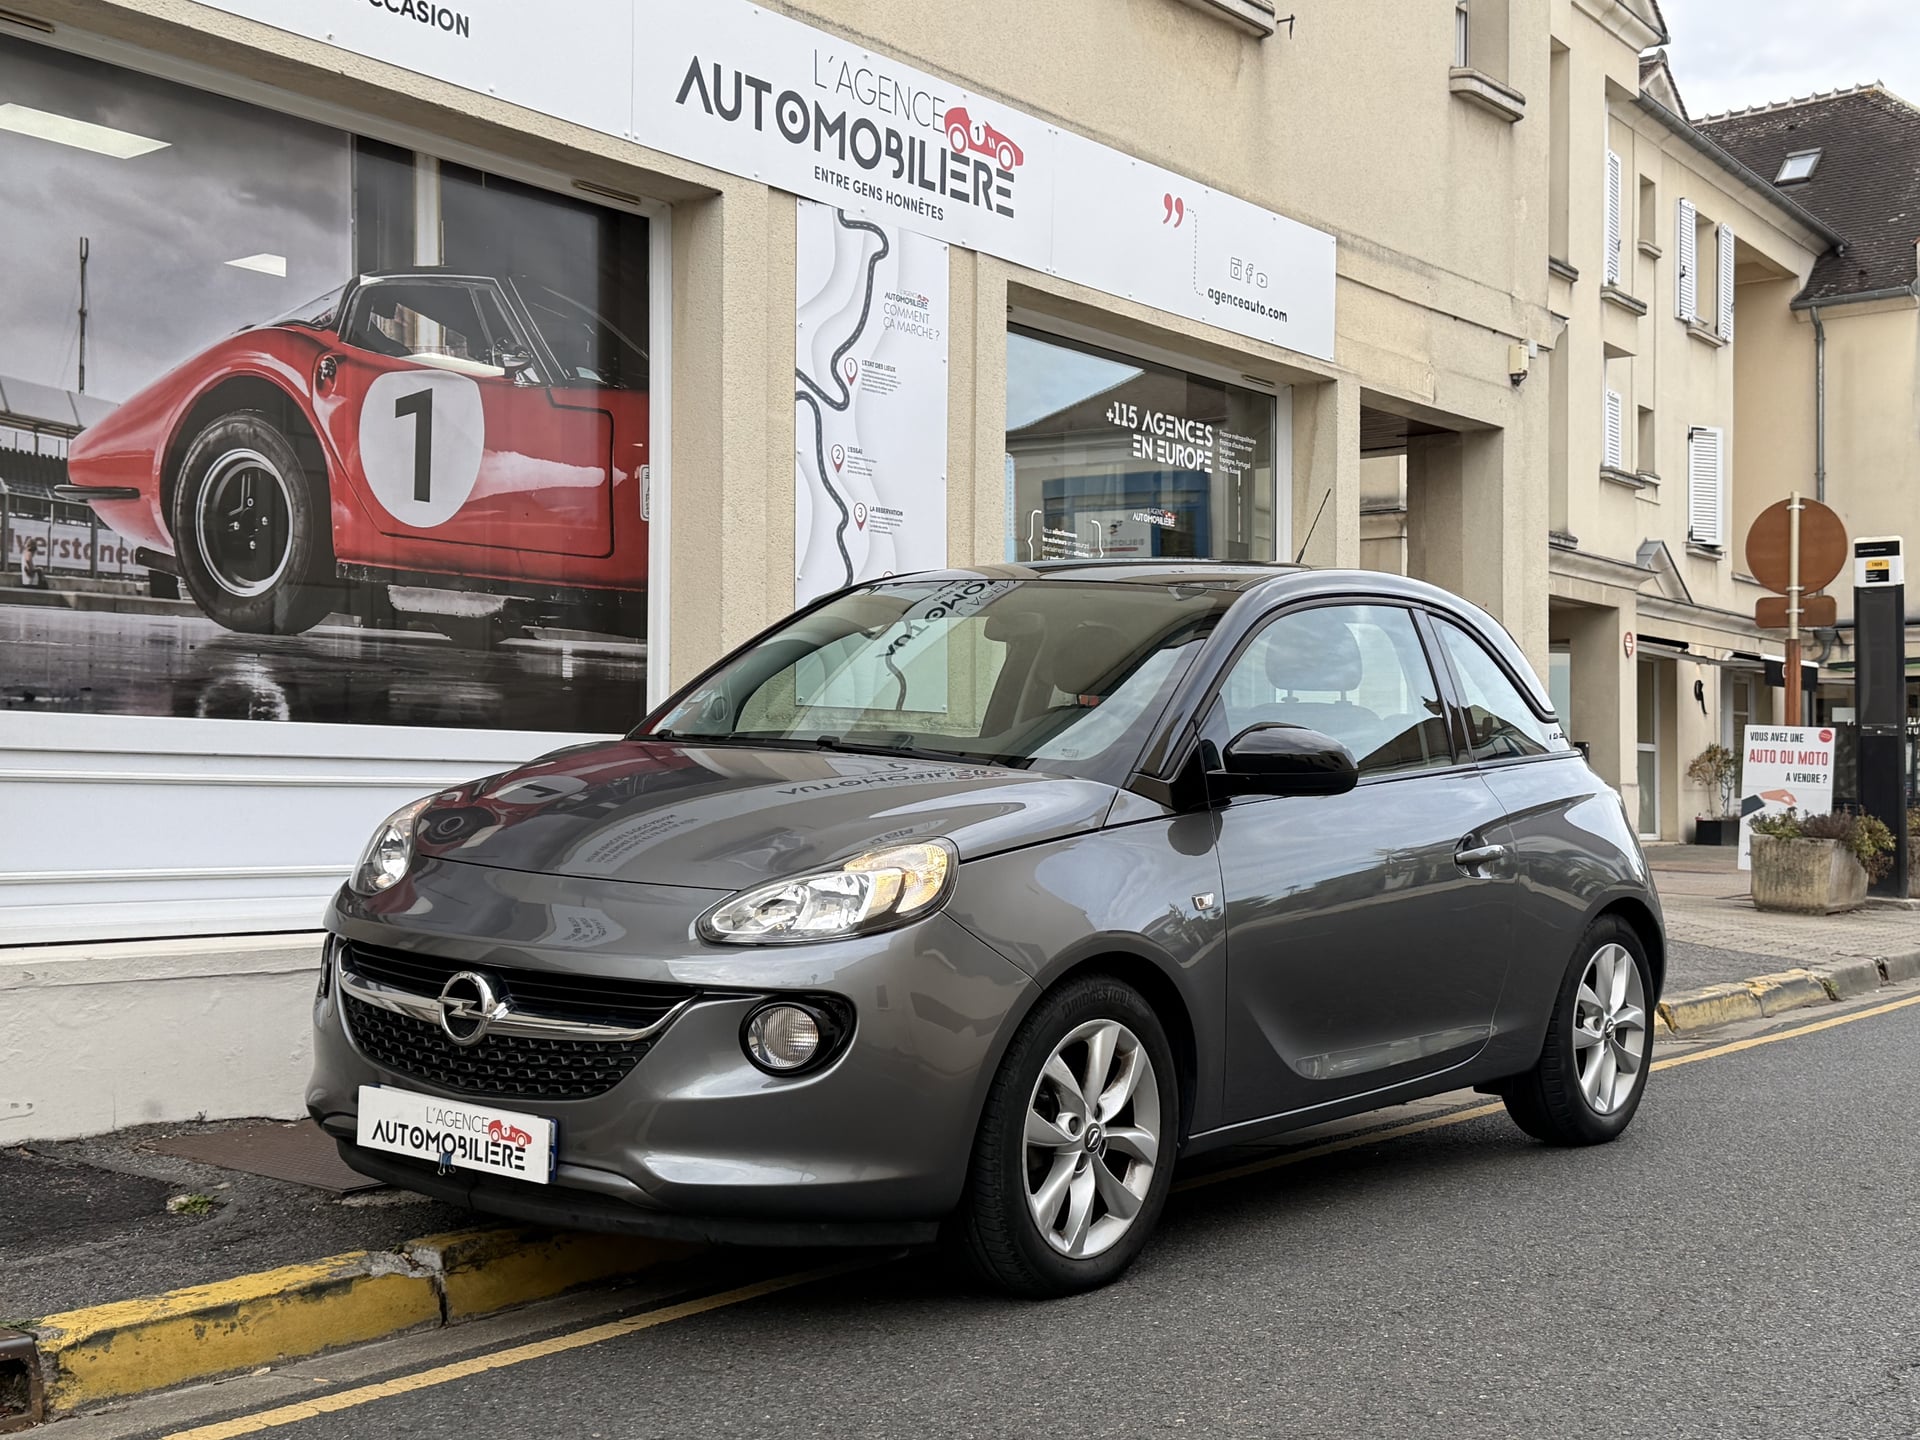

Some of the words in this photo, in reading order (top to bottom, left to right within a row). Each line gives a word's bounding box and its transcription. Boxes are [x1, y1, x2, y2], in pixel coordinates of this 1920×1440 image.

[814, 49, 945, 134] L'AGENCE
[815, 166, 850, 191] ENTRE
[853, 180, 883, 202] GENS
[886, 191, 944, 221] HONNÊTES
[884, 302, 930, 325] COMMENT
[1207, 287, 1288, 323] agenceauto.com
[897, 320, 934, 340] MARCHE
[1106, 401, 1138, 429] +115
[1141, 410, 1214, 447] AGENCES
[397, 388, 433, 502] 1
[1132, 433, 1153, 461] EN
[1157, 439, 1214, 474] EUROPE
[1750, 732, 1769, 741] VOUS
[1770, 732, 1788, 742] AVEZ
[1790, 733, 1804, 743] UNE
[1749, 749, 1776, 764] AUTO
[1780, 750, 1794, 765] OU
[1798, 751, 1828, 766] MOTO
[1785, 772, 1790, 782] A
[1793, 773, 1820, 783] VENDRE
[426, 1106, 489, 1135] L'AGENCE
